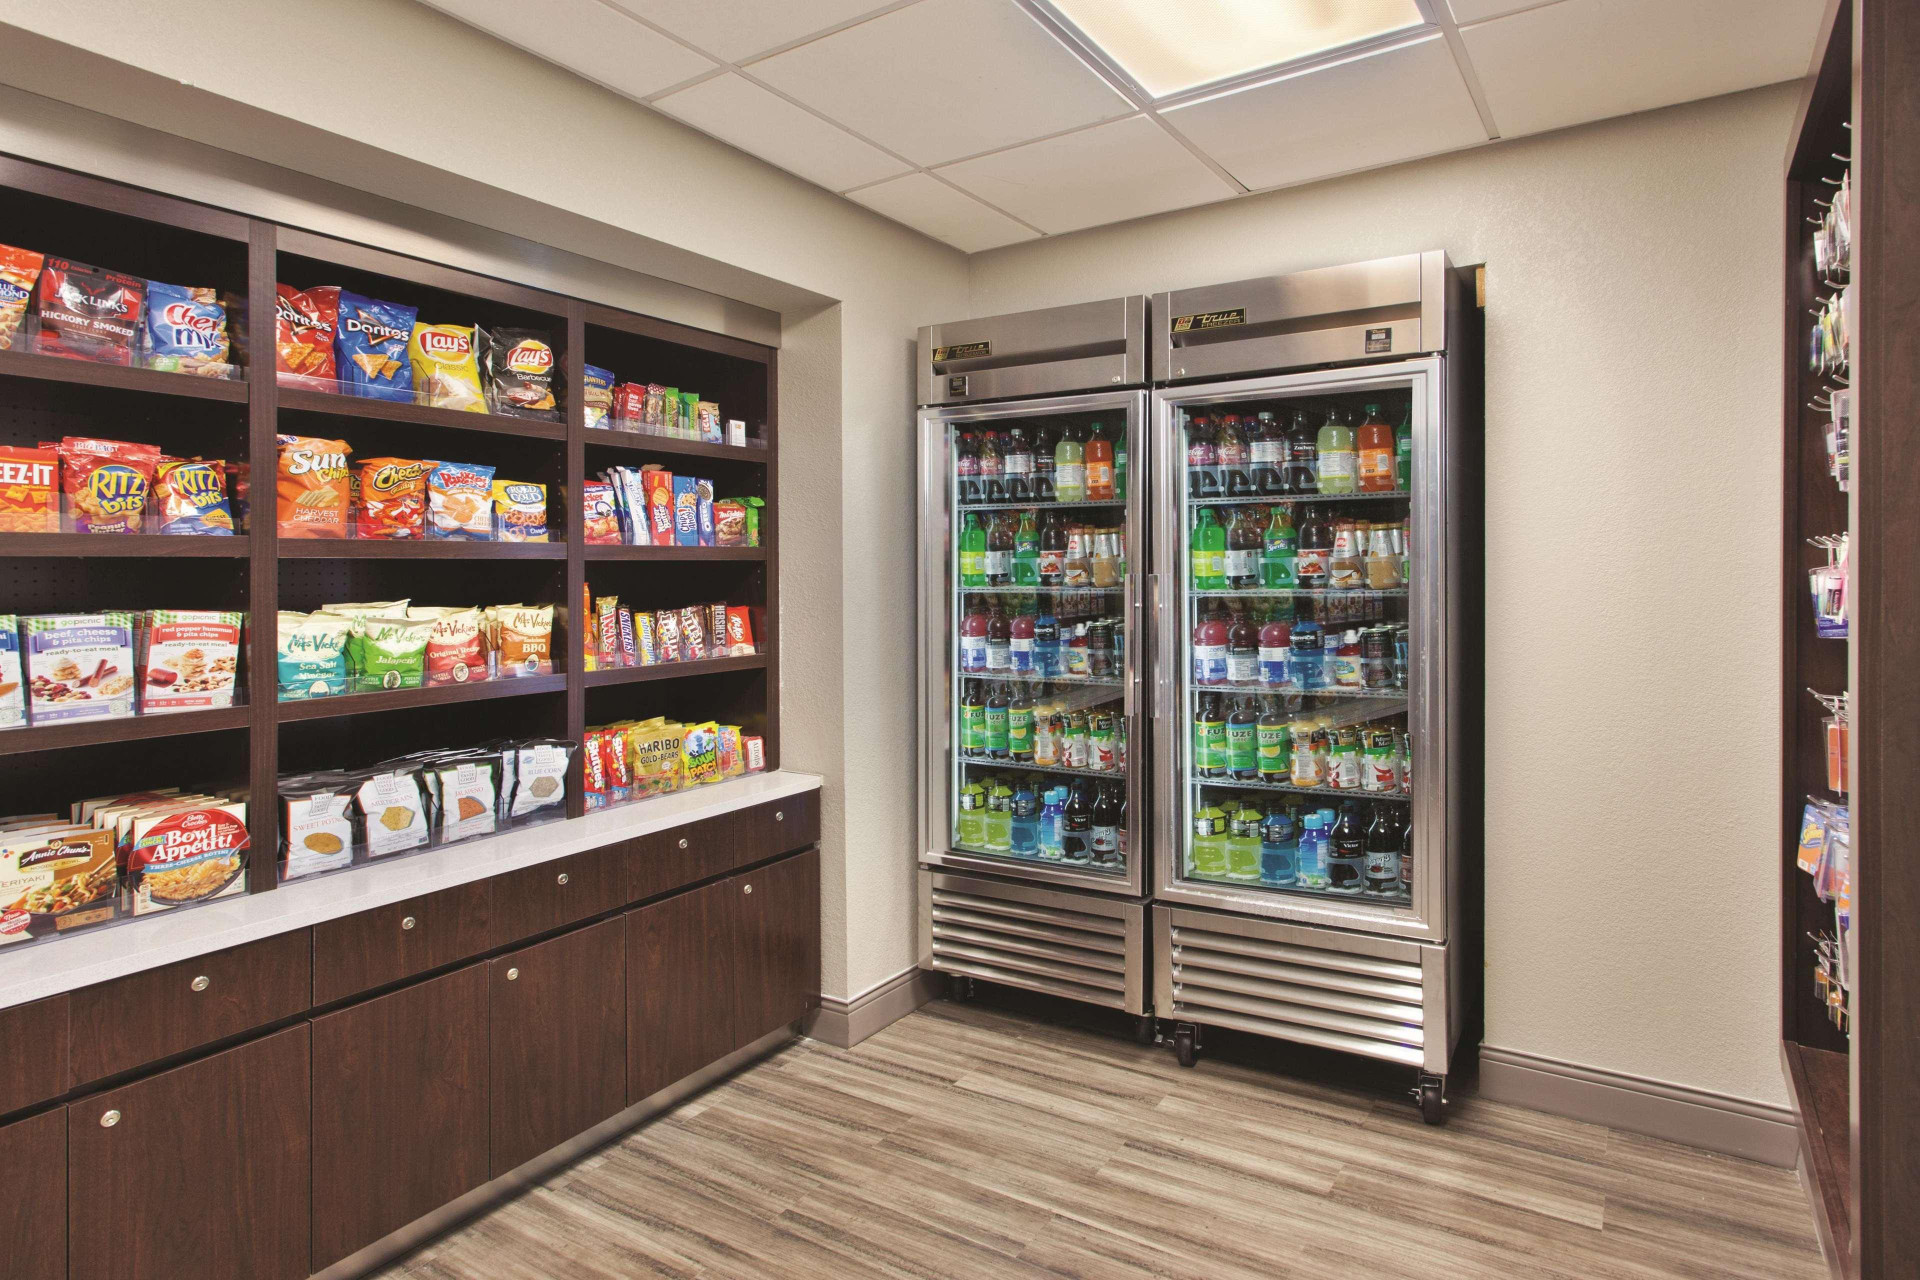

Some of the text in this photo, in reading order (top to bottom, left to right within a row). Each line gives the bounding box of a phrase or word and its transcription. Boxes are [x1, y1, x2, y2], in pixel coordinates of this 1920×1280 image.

[47, 258, 69, 270] 110
[41, 310, 134, 337] HICKORY SMOKED
[166, 304, 218, 332] Chex
[347, 318, 409, 341] Doritos
[426, 332, 469, 353] Lay's
[510, 348, 551, 366] Lay's
[434, 362, 470, 373] Classic
[289, 450, 346, 475] Sun
[0, 462, 54, 486] EZ-IT
[175, 469, 217, 494] RITZ
[91, 470, 144, 498] RITZ
[509, 485, 538, 493] ROLD
[101, 495, 143, 513] bits
[190, 491, 222, 507] bits
[511, 493, 542, 501] GOLD
[296, 507, 339, 517] HARVEST
[1267, 542, 1287, 551] Sprite
[61, 618, 101, 626] gopicnic
[600, 608, 616, 652] TWIX
[715, 605, 726, 645] HERSHEY'S
[45, 630, 73, 640] beef,
[62, 637, 83, 645] pita
[620, 612, 635, 654] SNICKERS
[46, 647, 97, 656] ready-to-eat
[430, 649, 459, 659] Original
[522, 644, 546, 653] BBQ
[299, 660, 337, 671] Sea Salt
[639, 738, 680, 755] HARIBO
[587, 740, 602, 788] Skittles
[640, 750, 679, 765] GOLD-BEARS
[688, 751, 715, 766] SOUR
[293, 821, 319, 832] SWEET
[165, 824, 218, 848] Bowl
[21, 845, 90, 866] Annie Chun's
[150, 849, 229, 870] THREE-CHEESE ROTINI
